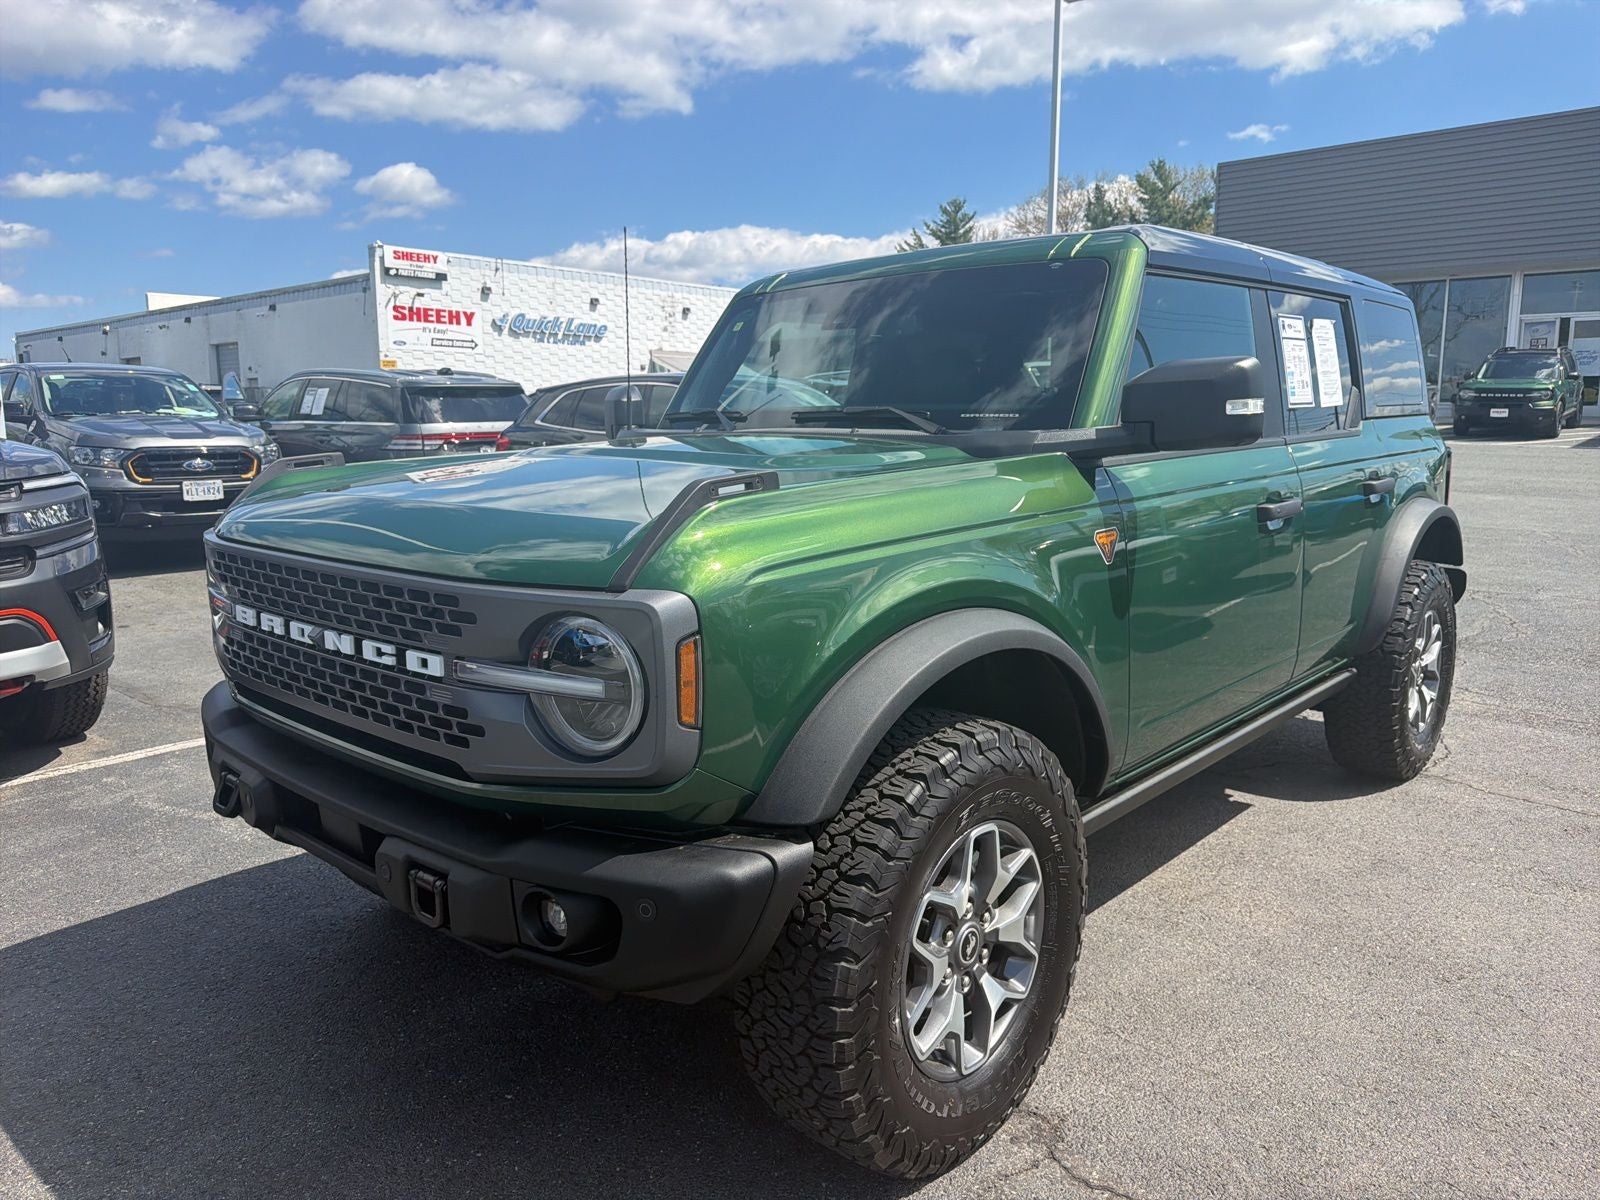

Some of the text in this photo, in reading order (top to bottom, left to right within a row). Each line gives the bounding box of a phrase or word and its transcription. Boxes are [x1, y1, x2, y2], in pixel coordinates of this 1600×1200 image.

[393, 250, 438, 264] SHEEHY
[392, 304, 476, 327] SHEEHY
[511, 312, 608, 337] Quick Lane
[433, 339, 452, 347] Service
[235, 604, 445, 678] BRONCO
